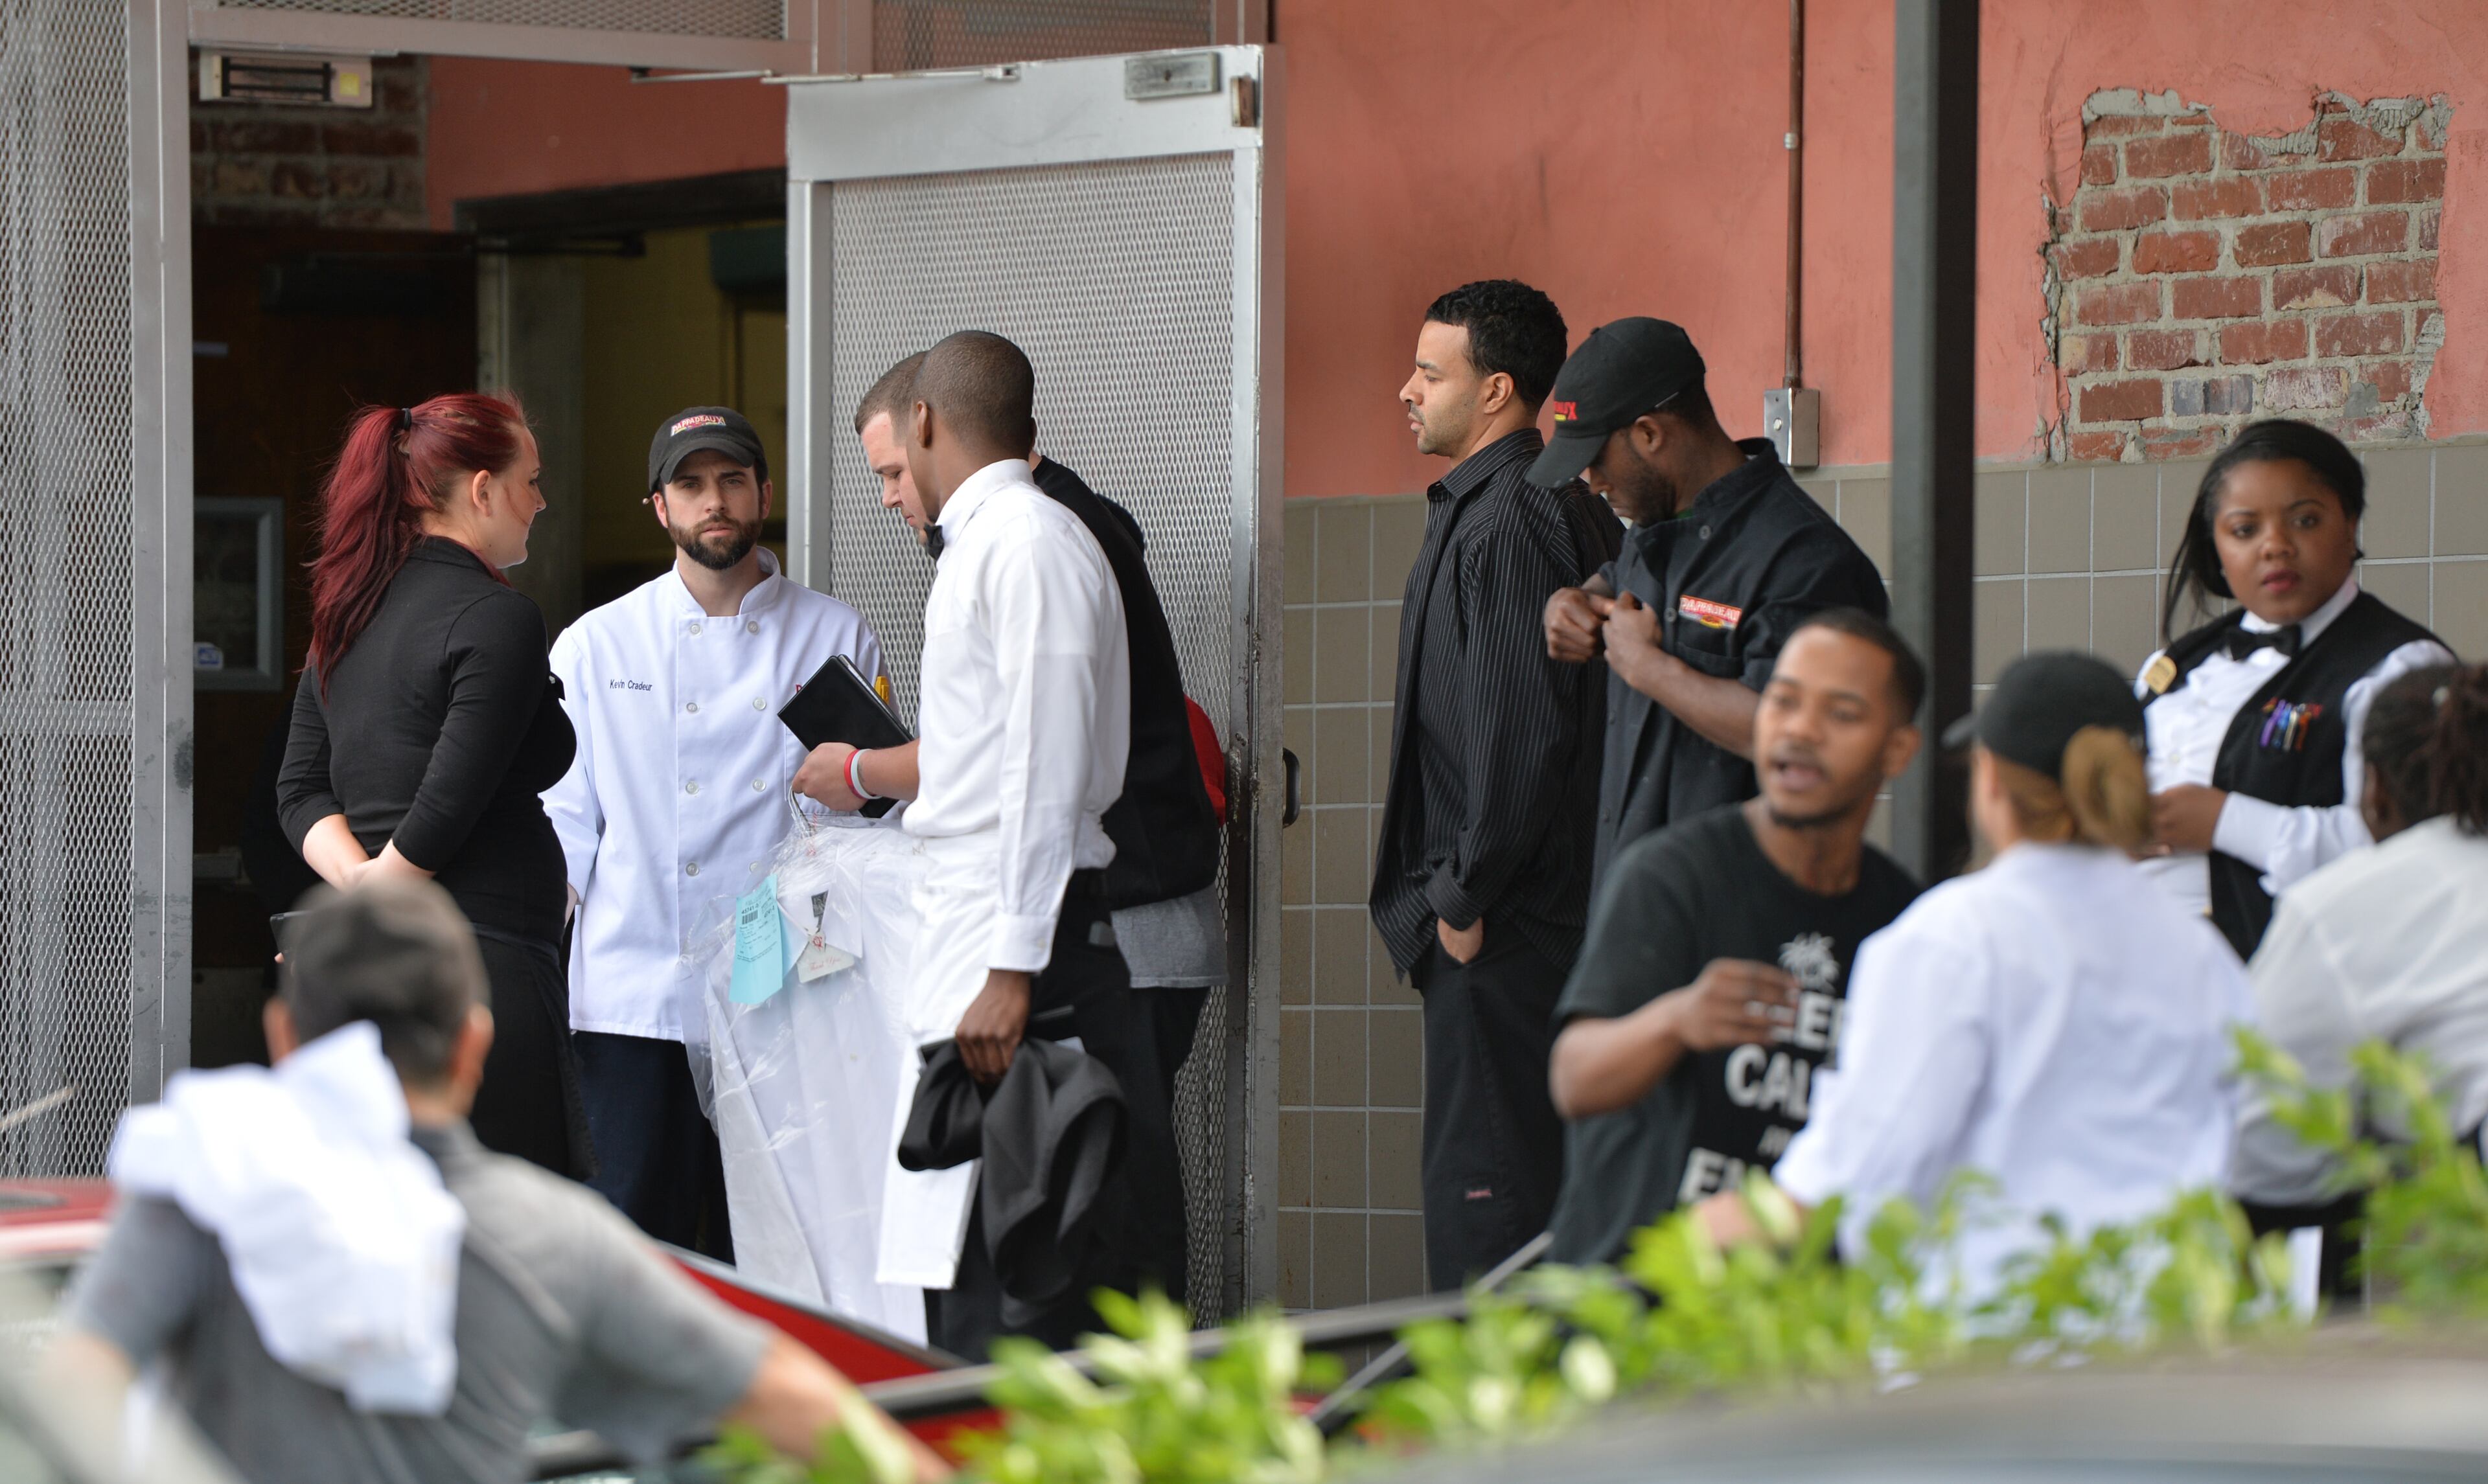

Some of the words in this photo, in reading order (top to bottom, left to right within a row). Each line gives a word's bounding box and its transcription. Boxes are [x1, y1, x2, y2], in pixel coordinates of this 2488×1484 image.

[610, 679, 625, 689] Kevin
[628, 680, 652, 691] Cradeur
[1725, 1044, 1811, 1122] CAL
